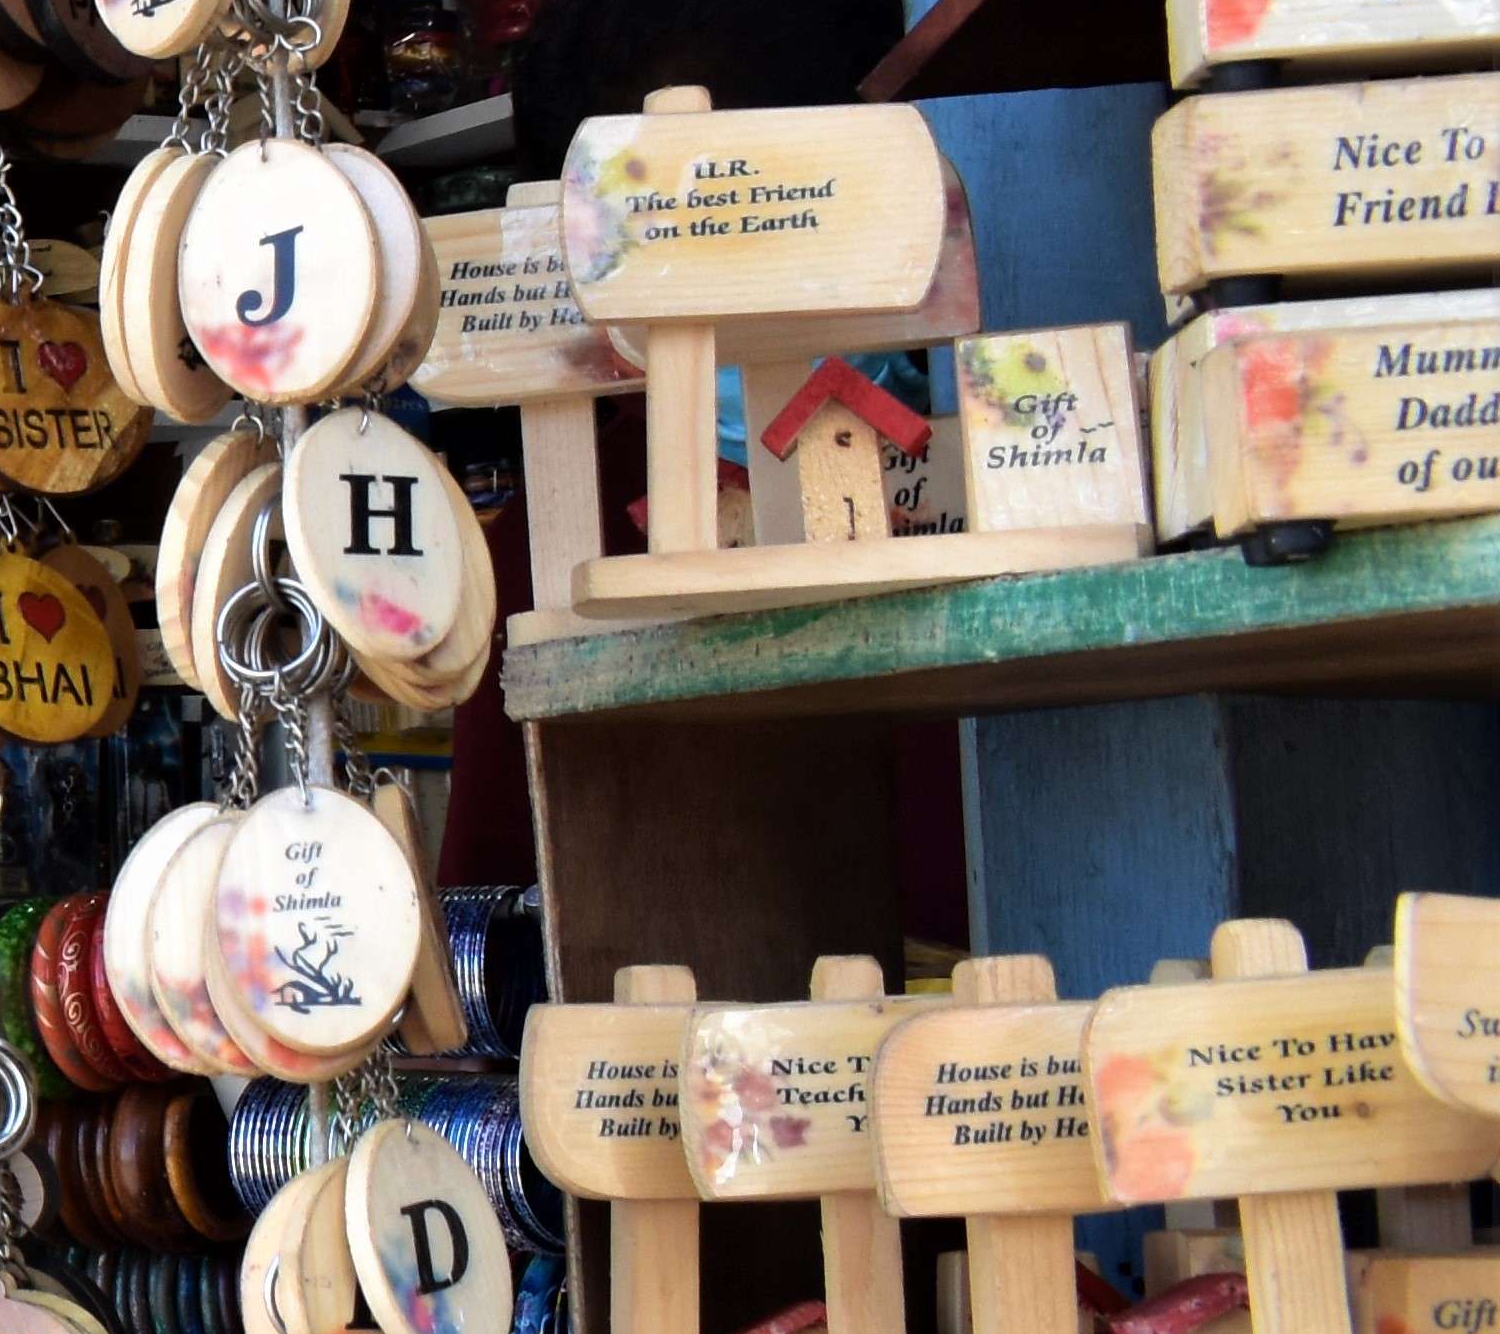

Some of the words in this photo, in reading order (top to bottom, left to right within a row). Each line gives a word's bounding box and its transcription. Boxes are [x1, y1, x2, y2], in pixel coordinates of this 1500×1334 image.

[1333, 134, 1422, 170] Nice
[1443, 127, 1486, 162] To
[626, 193, 678, 213] The
[686, 186, 739, 209] best
[747, 179, 837, 204] Friend
[1333, 185, 1468, 227] Friend
[644, 221, 681, 241] on
[689, 216, 731, 237] the
[739, 209, 819, 233] Earth
[236, 224, 304, 327] J
[1013, 391, 1079, 414] Gift
[1031, 419, 1066, 443] of
[987, 441, 1108, 468] Shimla
[338, 474, 424, 557] H
[284, 842, 323, 863] Gift
[295, 867, 317, 888] of
[272, 892, 343, 913] Shimla
[1188, 1044, 1261, 1067] Nice
[1272, 1038, 1315, 1058] To
[1329, 1032, 1395, 1053] Hav
[1216, 1070, 1310, 1097] Sister
[1324, 1064, 1393, 1086] Like
[1276, 1103, 1341, 1123] You
[400, 1198, 470, 1296] D
[1433, 1299, 1496, 1333] Gift
